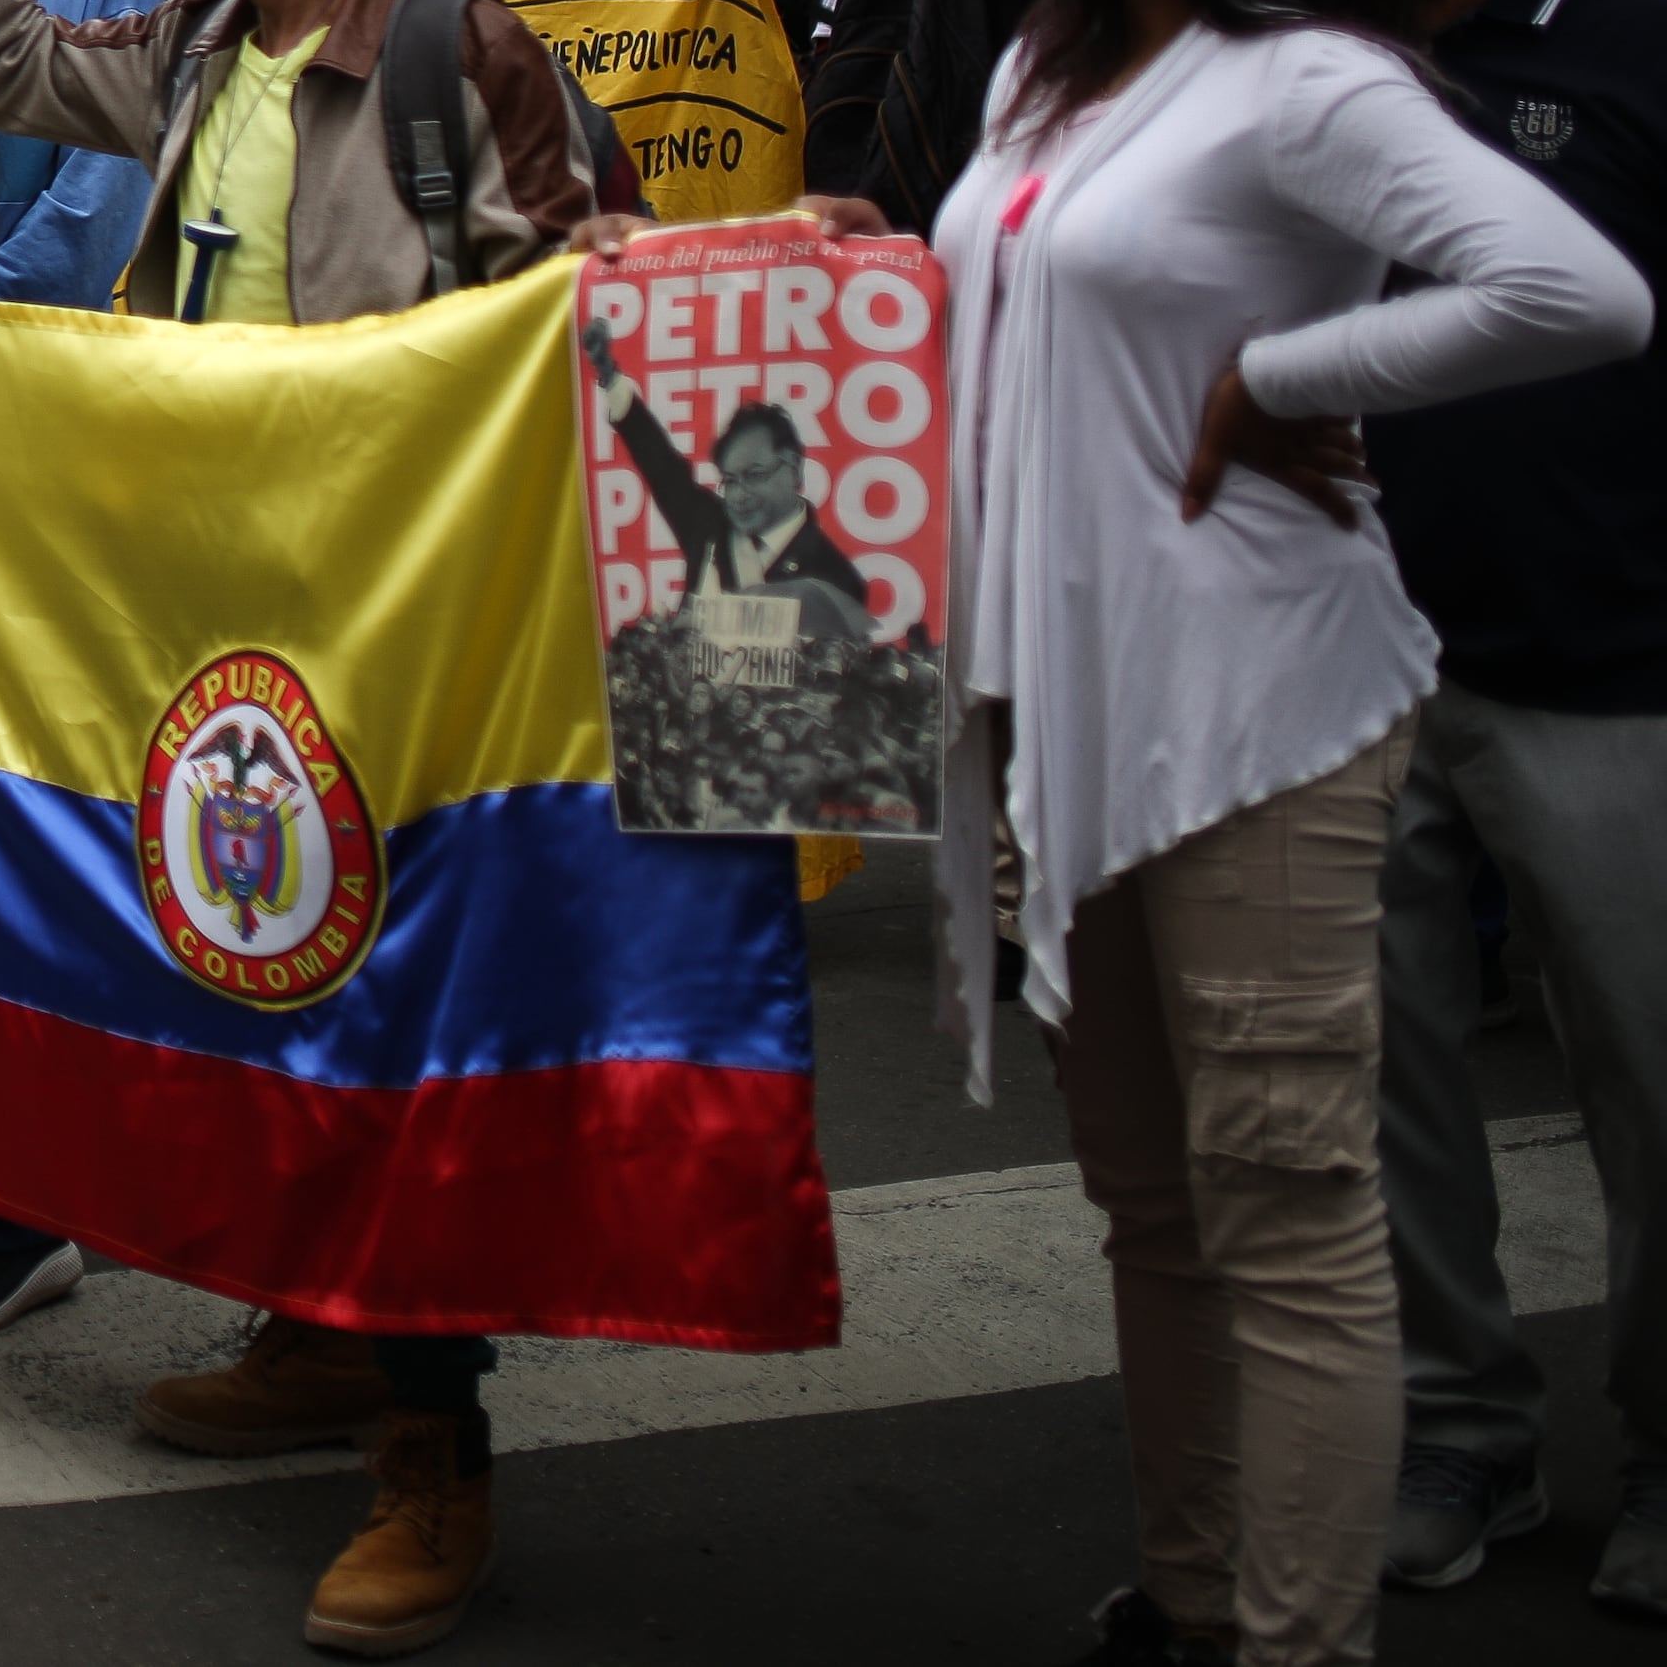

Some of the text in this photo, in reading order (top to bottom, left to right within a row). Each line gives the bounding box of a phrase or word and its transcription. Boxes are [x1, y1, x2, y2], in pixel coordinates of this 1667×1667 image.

[633, 125, 744, 181] TENGO
[670, 245, 701, 268] del
[706, 241, 779, 273] pueblo
[589, 266, 932, 362] PETRO
[156, 662, 340, 798] REPUBLICA
[145, 839, 367, 992] DE COLOMBIA
